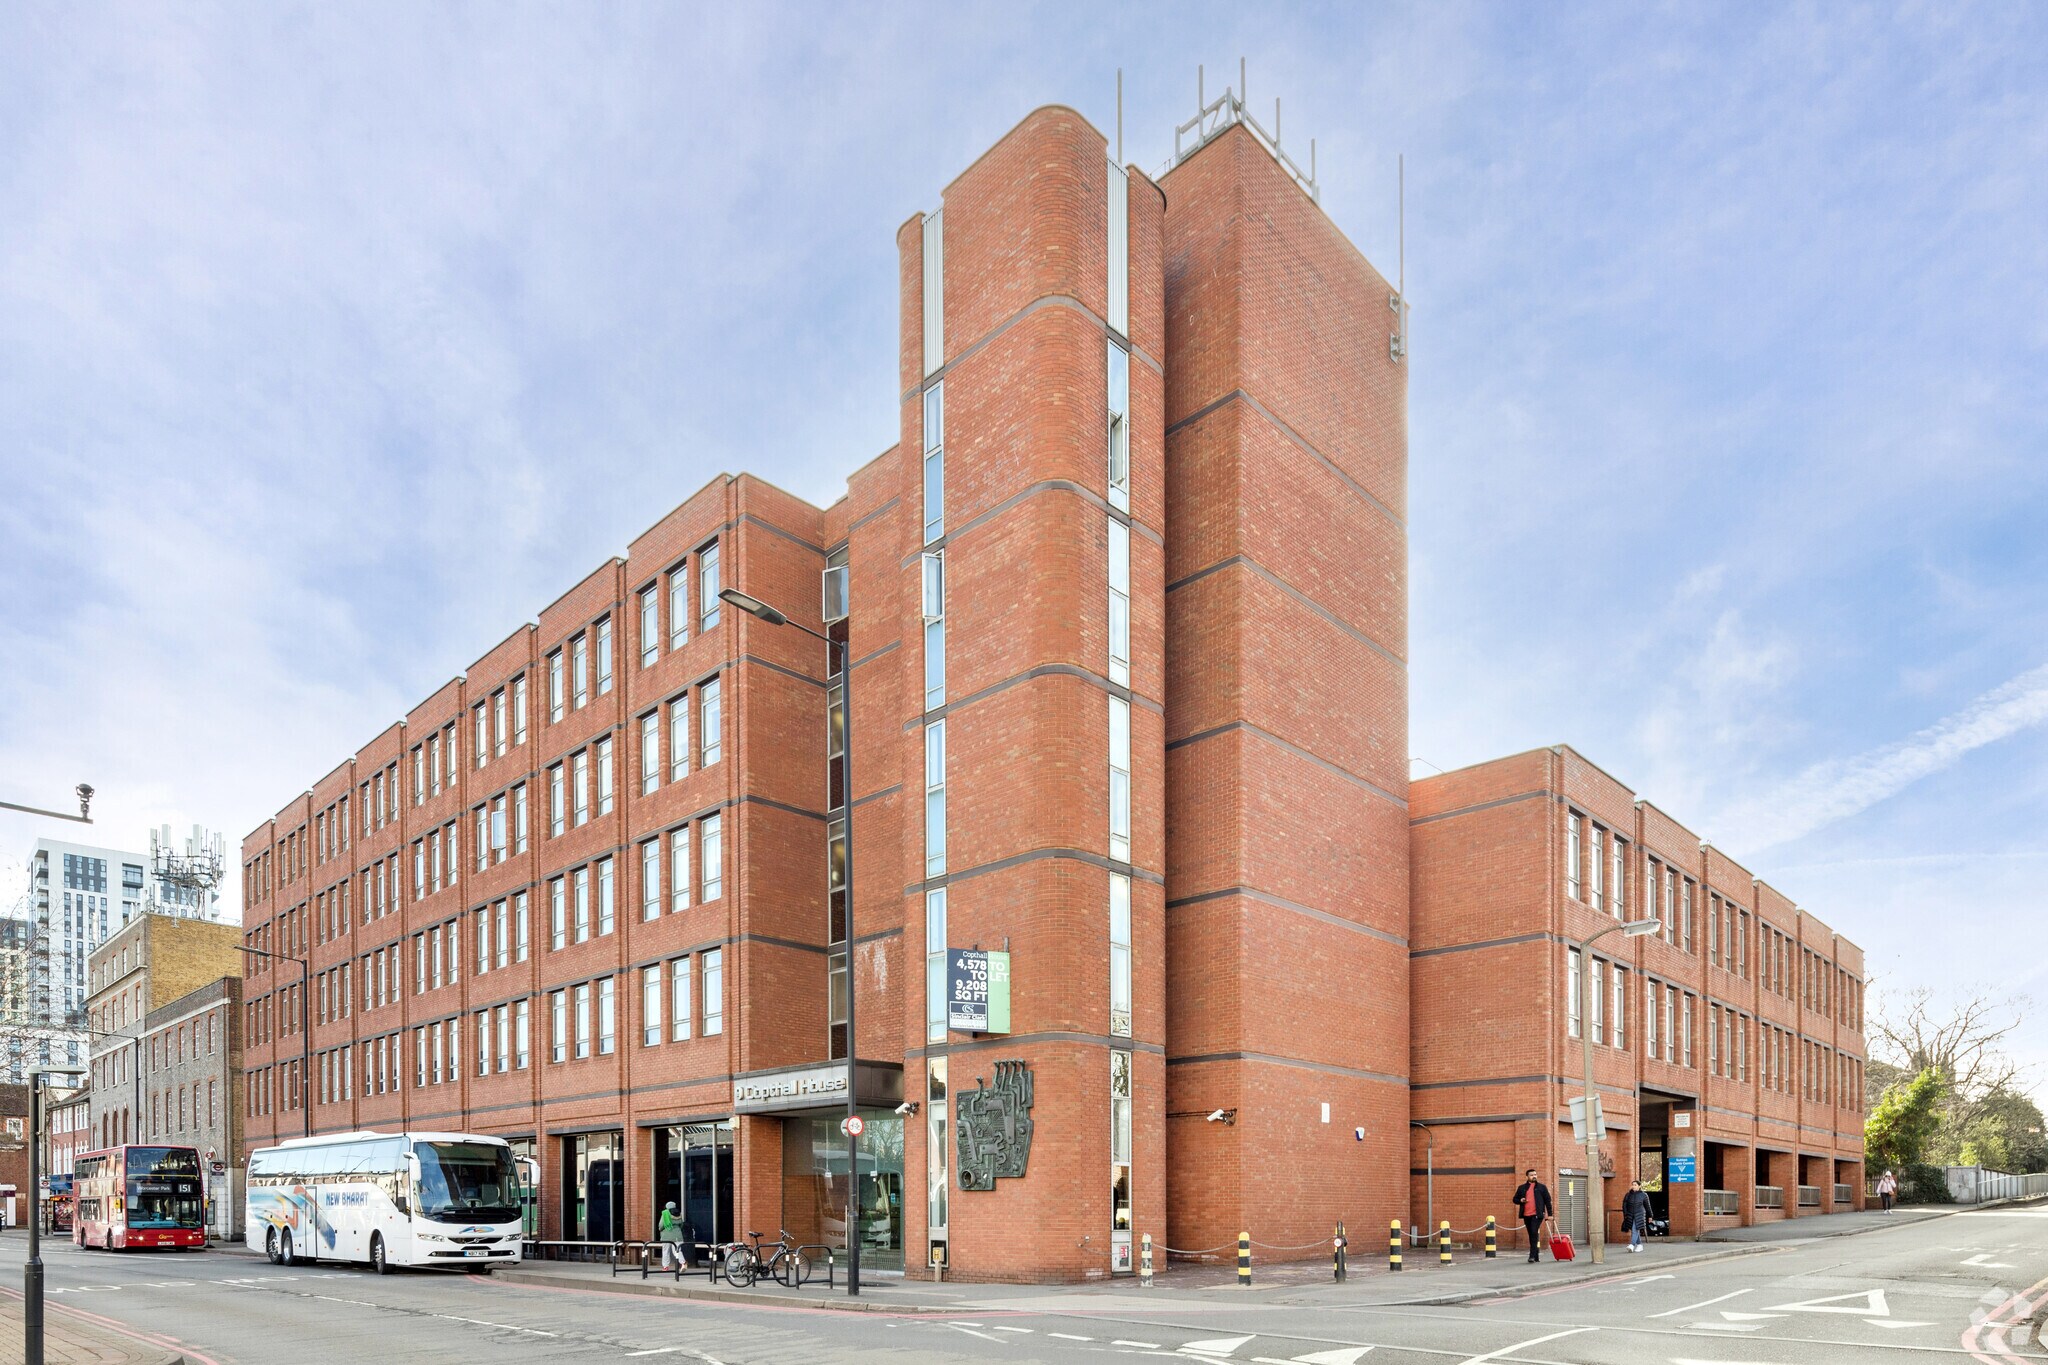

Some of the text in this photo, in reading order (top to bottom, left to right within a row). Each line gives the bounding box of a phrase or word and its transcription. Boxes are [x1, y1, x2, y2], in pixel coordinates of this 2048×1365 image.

[962, 951, 988, 959] Copthall
[956, 959, 987, 970] 4,578
[990, 961, 1005, 972] TO
[970, 970, 987, 980] TO
[990, 971, 1009, 982] LET
[955, 979, 987, 991] 9,208
[955, 990, 987, 1001] SQ FT
[179, 1184, 191, 1192] 151
[326, 1191, 369, 1206] NEW BHARAT
